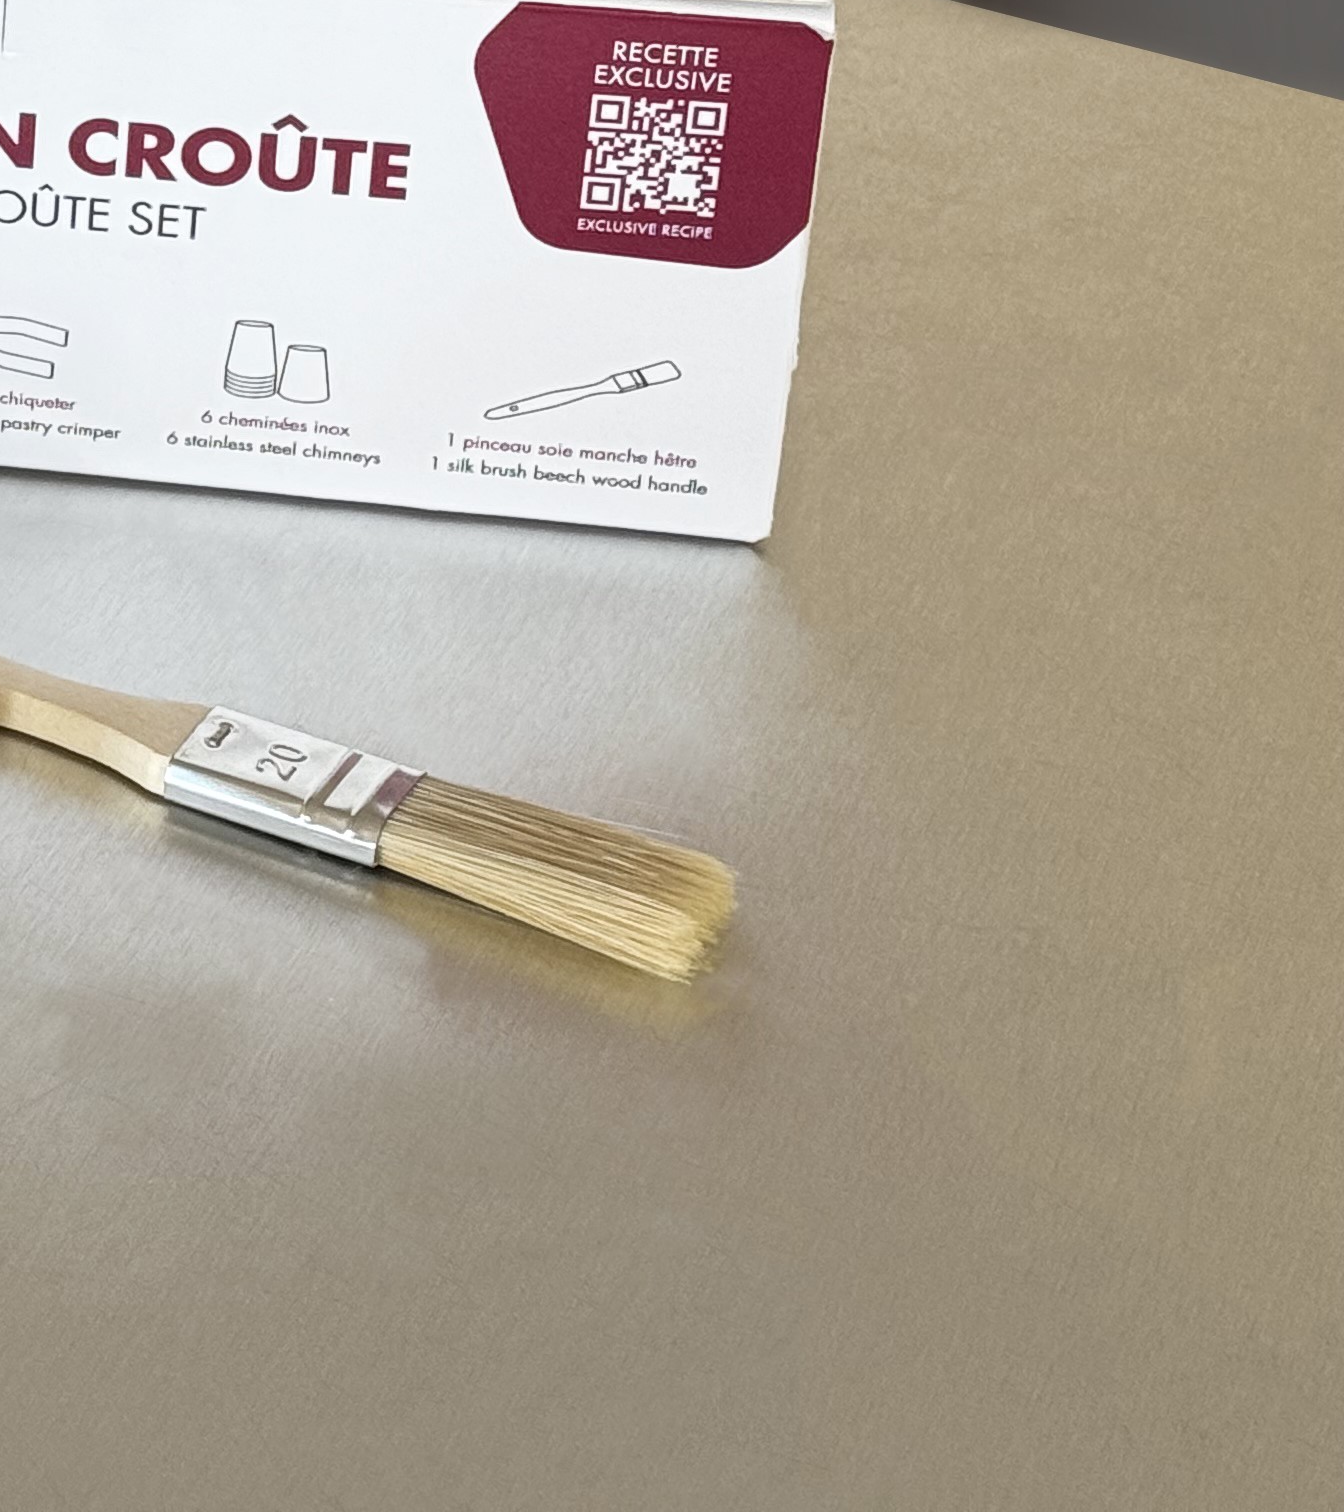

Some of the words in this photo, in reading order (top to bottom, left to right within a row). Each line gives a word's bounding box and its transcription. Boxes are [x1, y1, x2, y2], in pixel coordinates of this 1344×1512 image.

[612, 40, 720, 68] RECETTE
[593, 64, 733, 93] EXCLUSIVE
[68, 113, 412, 201] CROÛTE
[128, 201, 207, 241] SET
[576, 218, 657, 236] EXCLUSIVE
[661, 224, 714, 240] RECIPE
[0, 391, 77, 411] chiqueter
[0, 416, 53, 437] pastry
[57, 422, 122, 442] crimper
[200, 409, 213, 424] 6
[218, 411, 308, 434] cheminées
[314, 420, 351, 437] inox
[166, 431, 179, 445] 6
[184, 434, 254, 453] stainless
[259, 441, 297, 457] steel
[302, 443, 382, 468] chimneys
[448, 432, 455, 448] 1
[463, 435, 532, 455] pinceau
[538, 442, 574, 458] soie
[579, 447, 648, 465] manche
[654, 449, 698, 469] hêtre
[432, 455, 439, 471] 1
[446, 457, 475, 474] silk
[481, 459, 528, 480] brush
[533, 465, 586, 485] beech
[591, 474, 643, 491] wood
[648, 476, 709, 496] handle
[255, 743, 308, 781] 20
